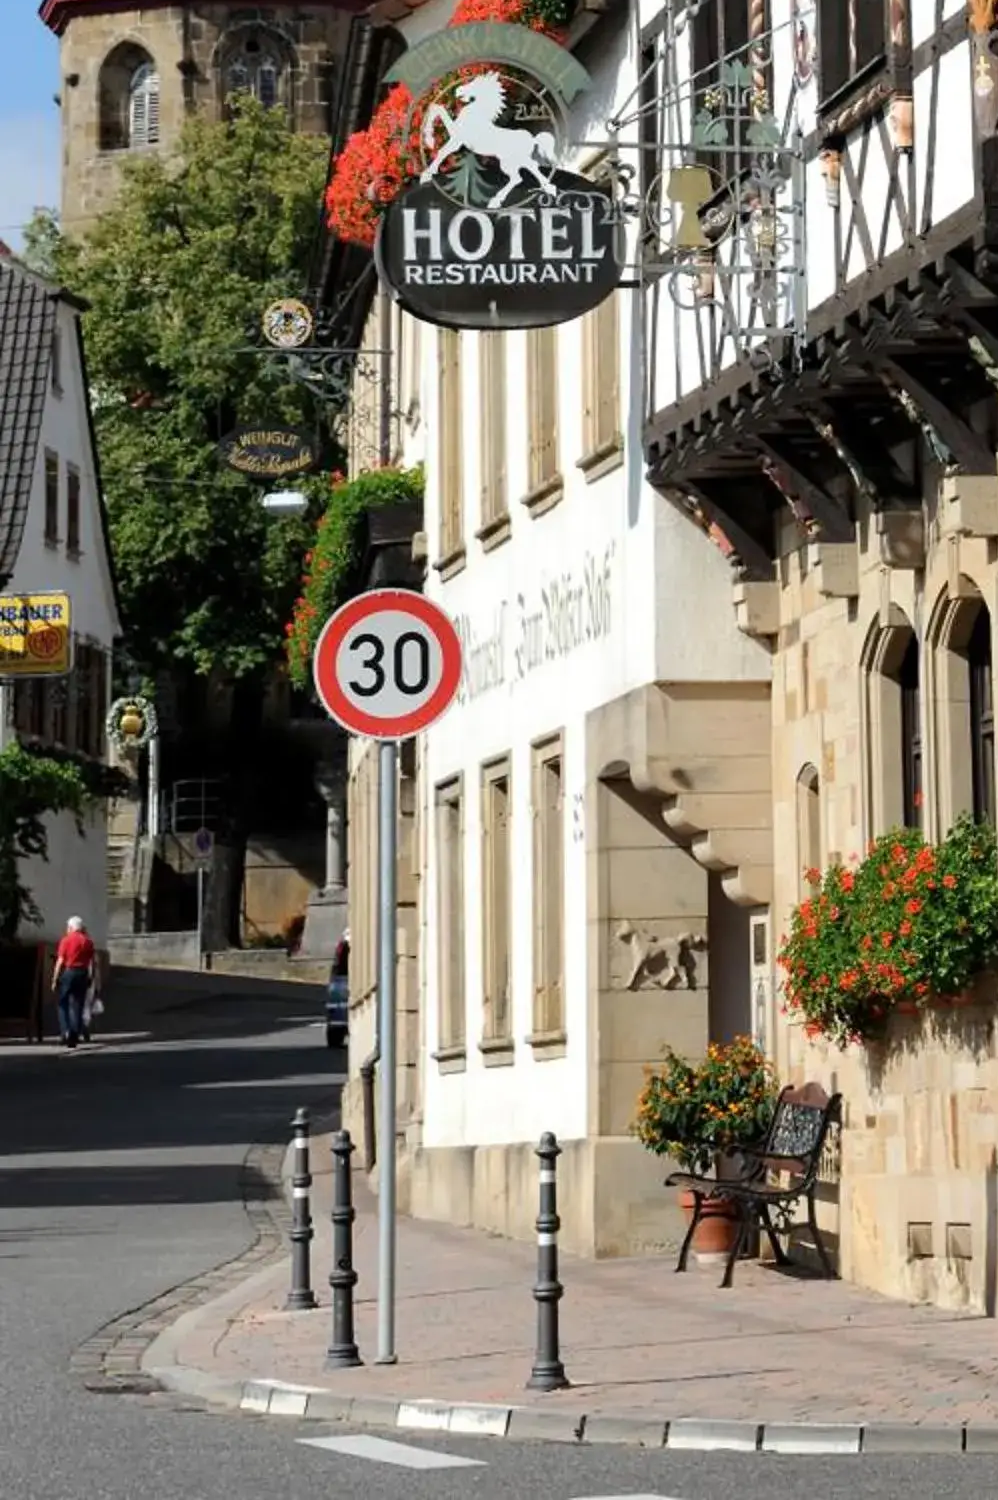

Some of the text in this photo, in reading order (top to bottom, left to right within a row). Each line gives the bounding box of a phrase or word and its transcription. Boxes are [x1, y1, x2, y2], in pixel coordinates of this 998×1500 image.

[402, 207, 607, 261] HOTEL
[404, 262, 599, 285] RESTAURANT
[349, 631, 429, 697] 30
